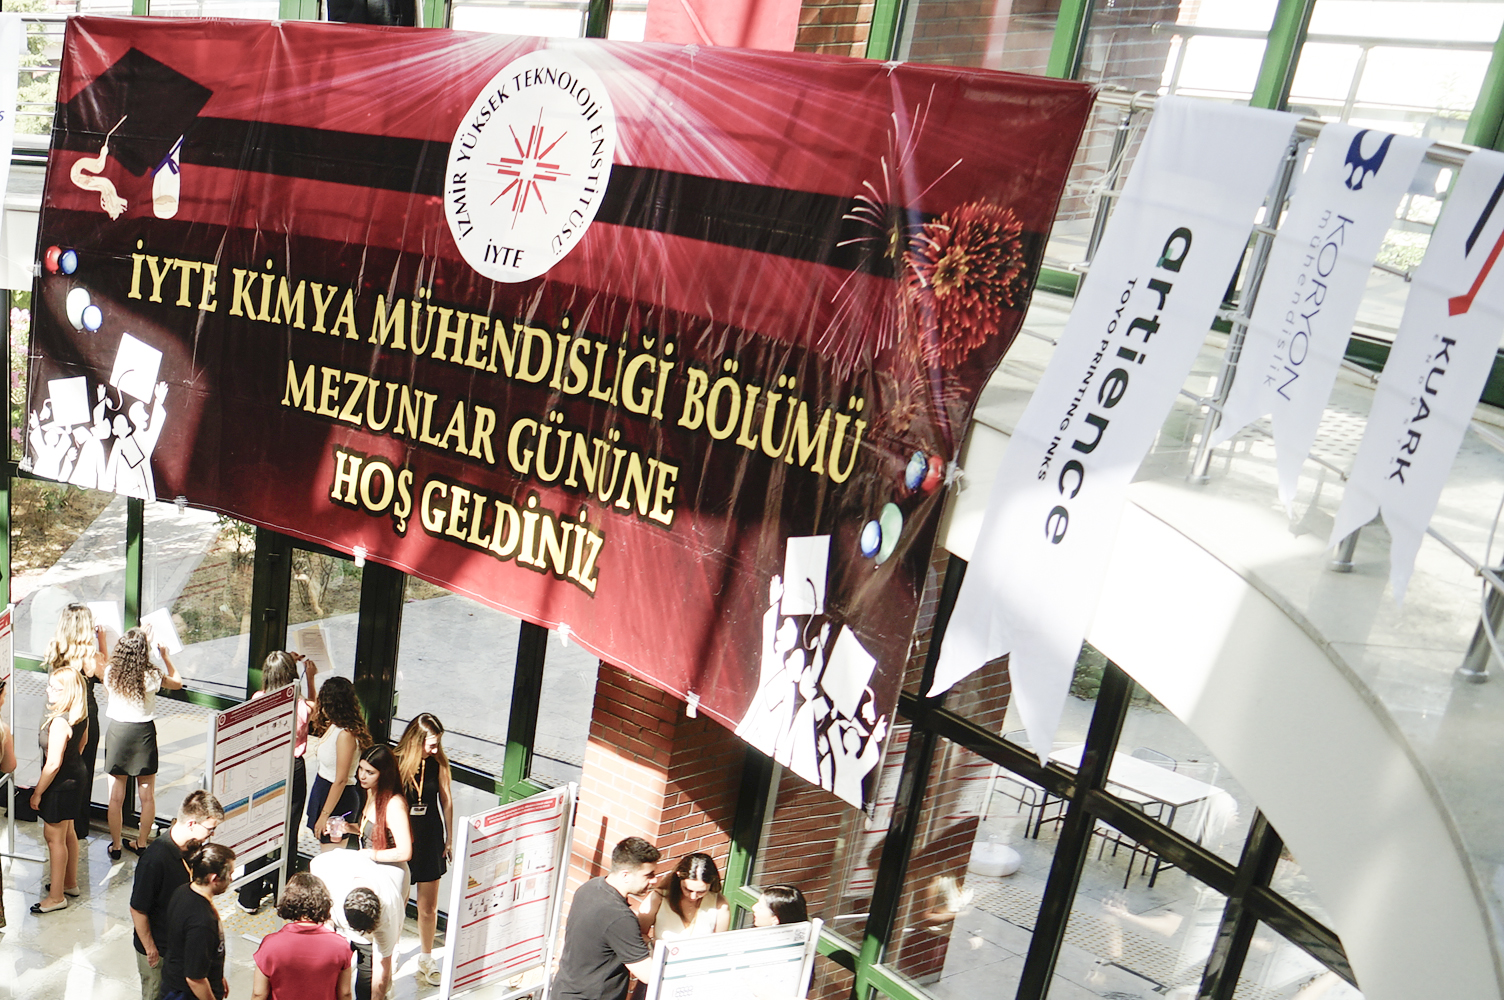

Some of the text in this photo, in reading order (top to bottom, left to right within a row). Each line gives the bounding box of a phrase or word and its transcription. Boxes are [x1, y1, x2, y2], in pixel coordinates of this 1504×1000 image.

[448, 67, 604, 256] İZMİR YÜKSEK TEKNOLOJİ ENSTİTÜSÜ
[484, 238, 525, 269] İYTE
[1263, 209, 1332, 387] mühendislik
[1277, 215, 1354, 401] KORYON
[127, 239, 867, 484] İYTE KİMYA MÜHENDİSLİĞİ BÖLÜMÜ
[281, 359, 679, 526] MEZUNLAR GÜNÜNE
[1037, 277, 1139, 481] TOYO PRINTING INKS
[1045, 227, 1192, 544] artience
[1389, 337, 1456, 485] KUARK
[331, 450, 604, 594] HOŞ GELDİNİZ
